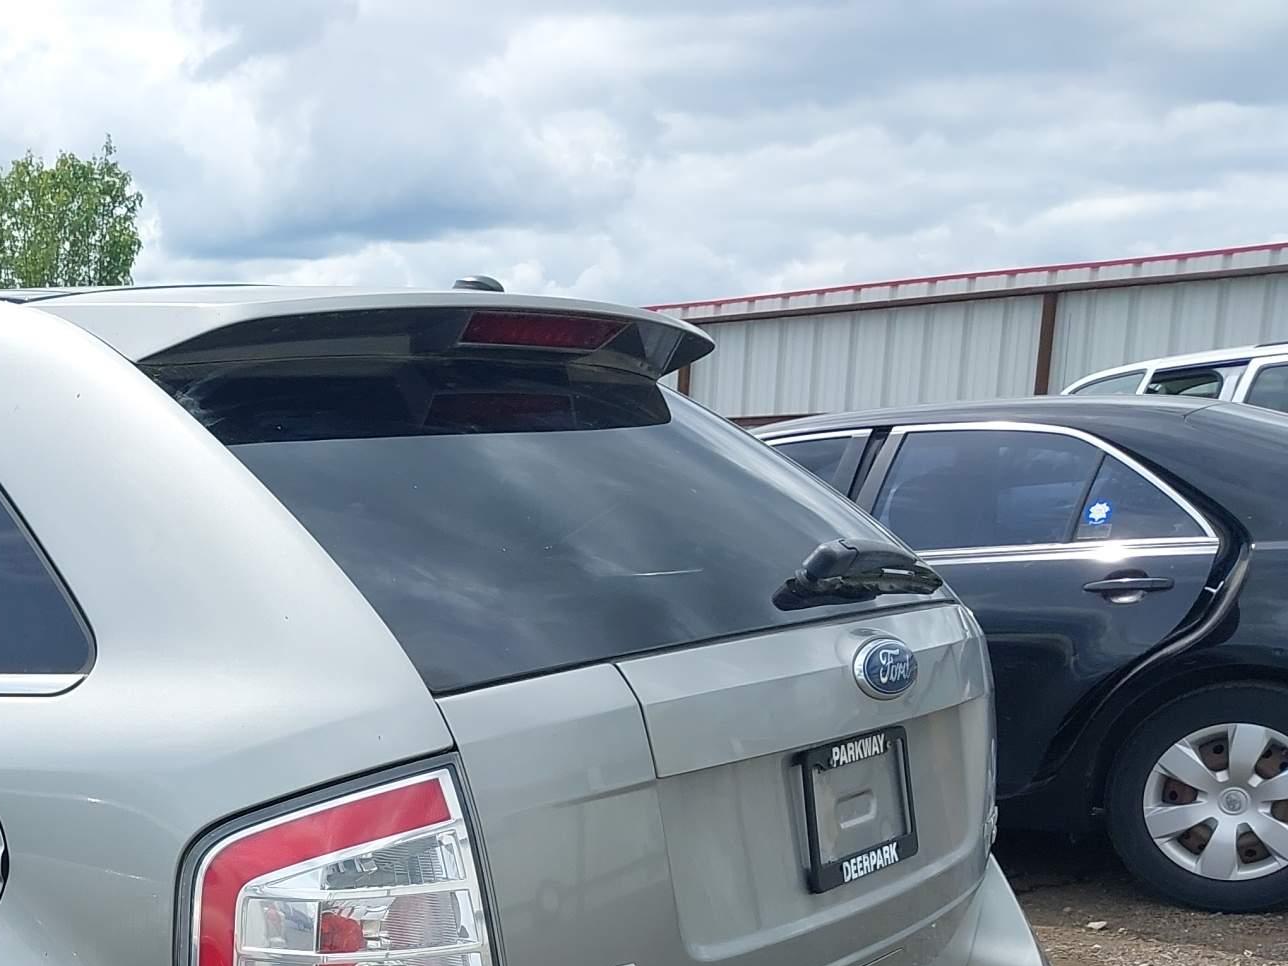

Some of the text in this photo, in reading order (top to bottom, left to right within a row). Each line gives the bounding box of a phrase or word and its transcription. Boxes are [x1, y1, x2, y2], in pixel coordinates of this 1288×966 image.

[879, 648, 912, 684] Ford
[831, 733, 886, 768] PARKWAY
[842, 842, 899, 883] DEERPARK
